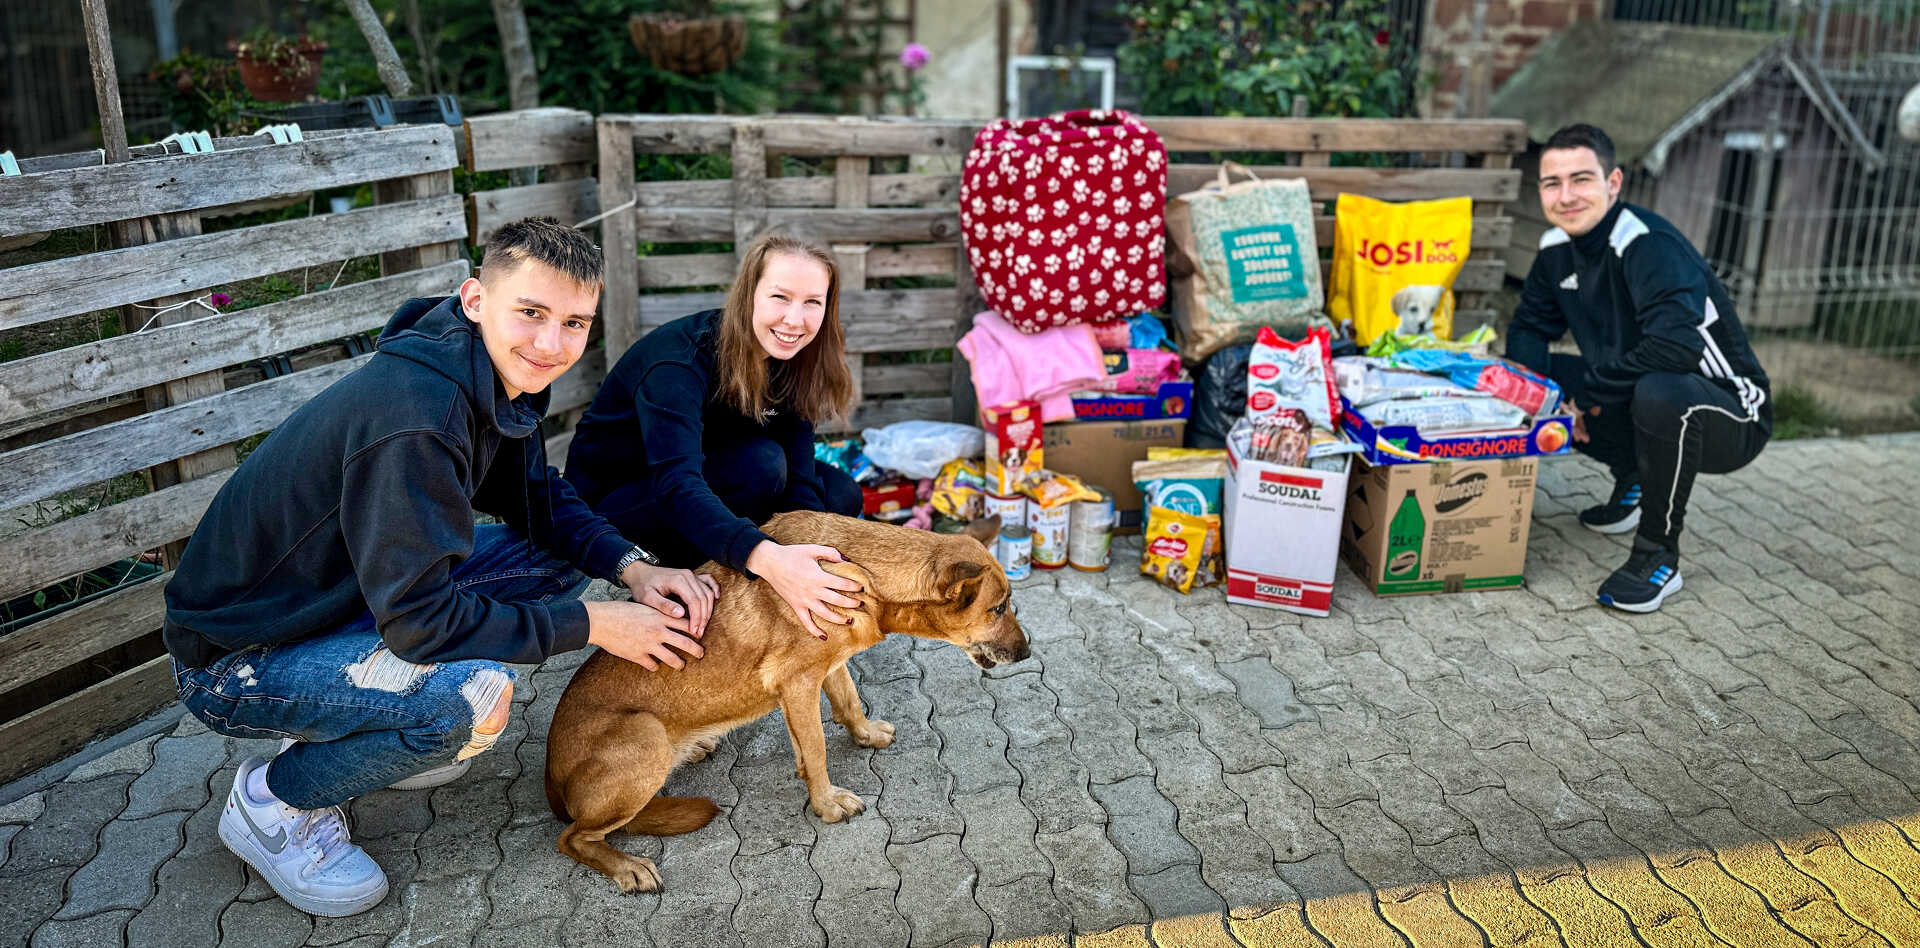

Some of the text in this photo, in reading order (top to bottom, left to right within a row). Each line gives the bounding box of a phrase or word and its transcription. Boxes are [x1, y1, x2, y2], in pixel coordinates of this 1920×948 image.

[1357, 239, 1423, 267] JOSI
[1427, 254, 1457, 263] DOG
[1418, 438, 1528, 458] BONSIGNORE
[1259, 482, 1321, 501] SOUDAL
[1256, 584, 1300, 598] SOUDAL
